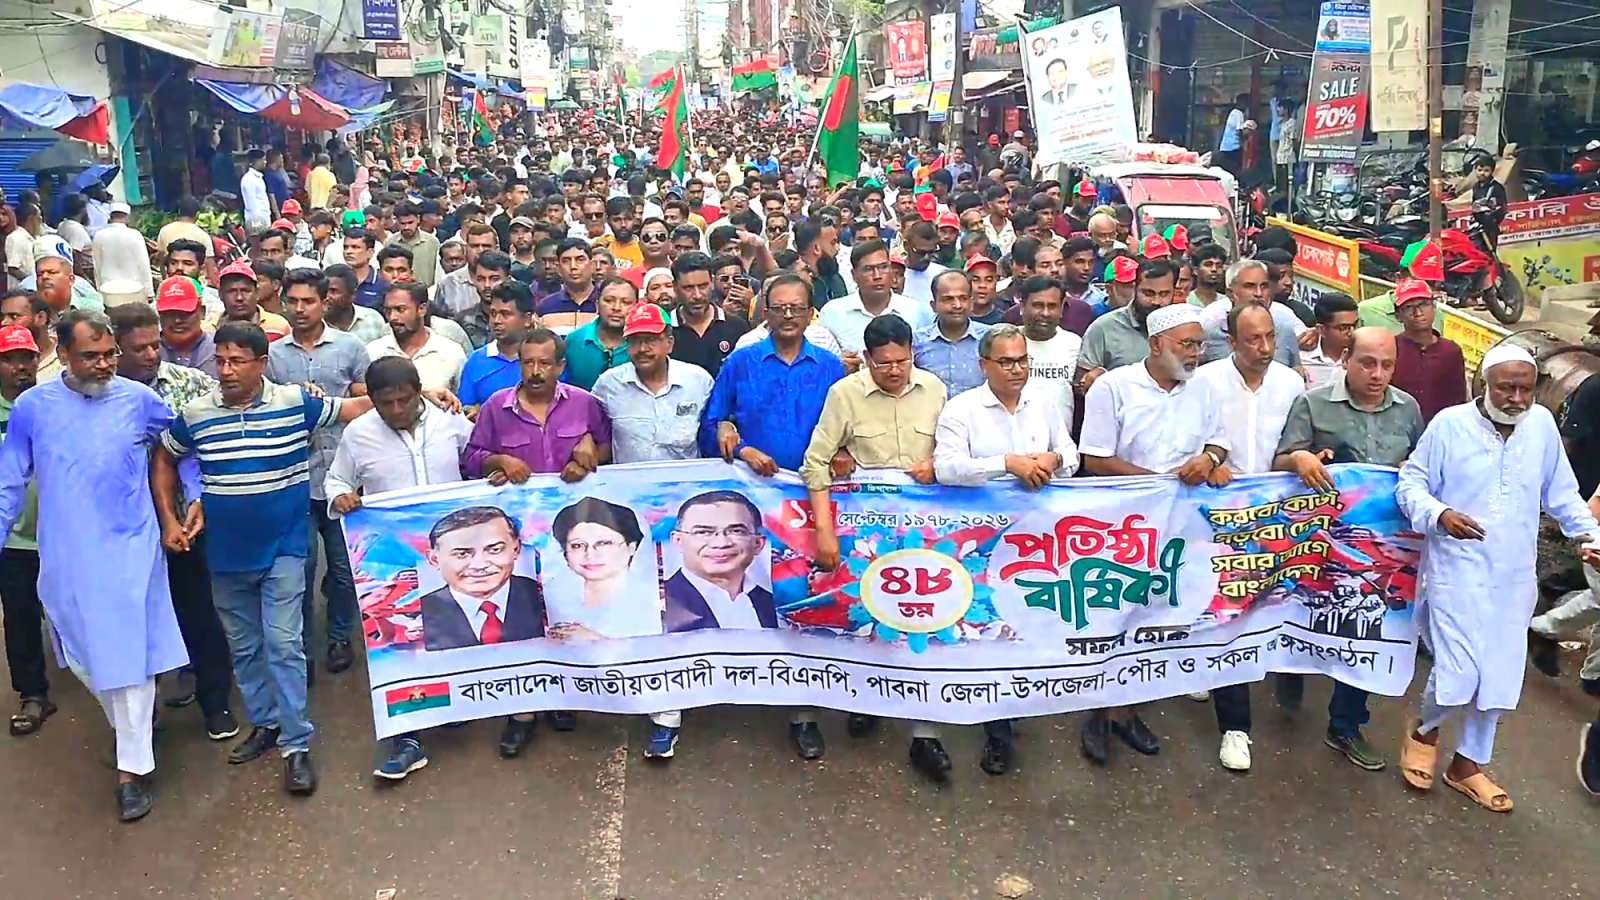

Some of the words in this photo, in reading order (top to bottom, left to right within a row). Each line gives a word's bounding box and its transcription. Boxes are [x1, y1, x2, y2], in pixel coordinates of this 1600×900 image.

[481, 33, 498, 41] ATM
[509, 8, 518, 55] LOTT
[1320, 77, 1360, 102] SALE
[1315, 104, 1357, 130] 70%
[1504, 201, 1570, 221] কারি
[1029, 365, 1069, 379] TINEERS
[837, 509, 898, 528] সেপ্টেম্বর
[904, 512, 1009, 528] ১৯৭৮-২০২৬
[1208, 502, 1280, 527] করবো
[1000, 514, 1157, 581] প্রতিষ্ঠা
[1211, 553, 1276, 573] সবার
[1279, 540, 1330, 563] আগে
[879, 566, 953, 596] ৪৮
[1014, 538, 1186, 631] বার্ষিকী
[897, 602, 935, 618] তম
[1134, 625, 1192, 644] হোক
[458, 673, 566, 702] বাংলাদেশ
[572, 659, 716, 697] জাতীয়তাবাদী
[722, 658, 858, 698] দল-বিএনপি,
[866, 674, 930, 702] পাবনা
[940, 657, 1169, 705] জেলা-উপজেলা-পৌর
[1177, 657, 1196, 674] ও
[1205, 645, 1262, 673] সকল
